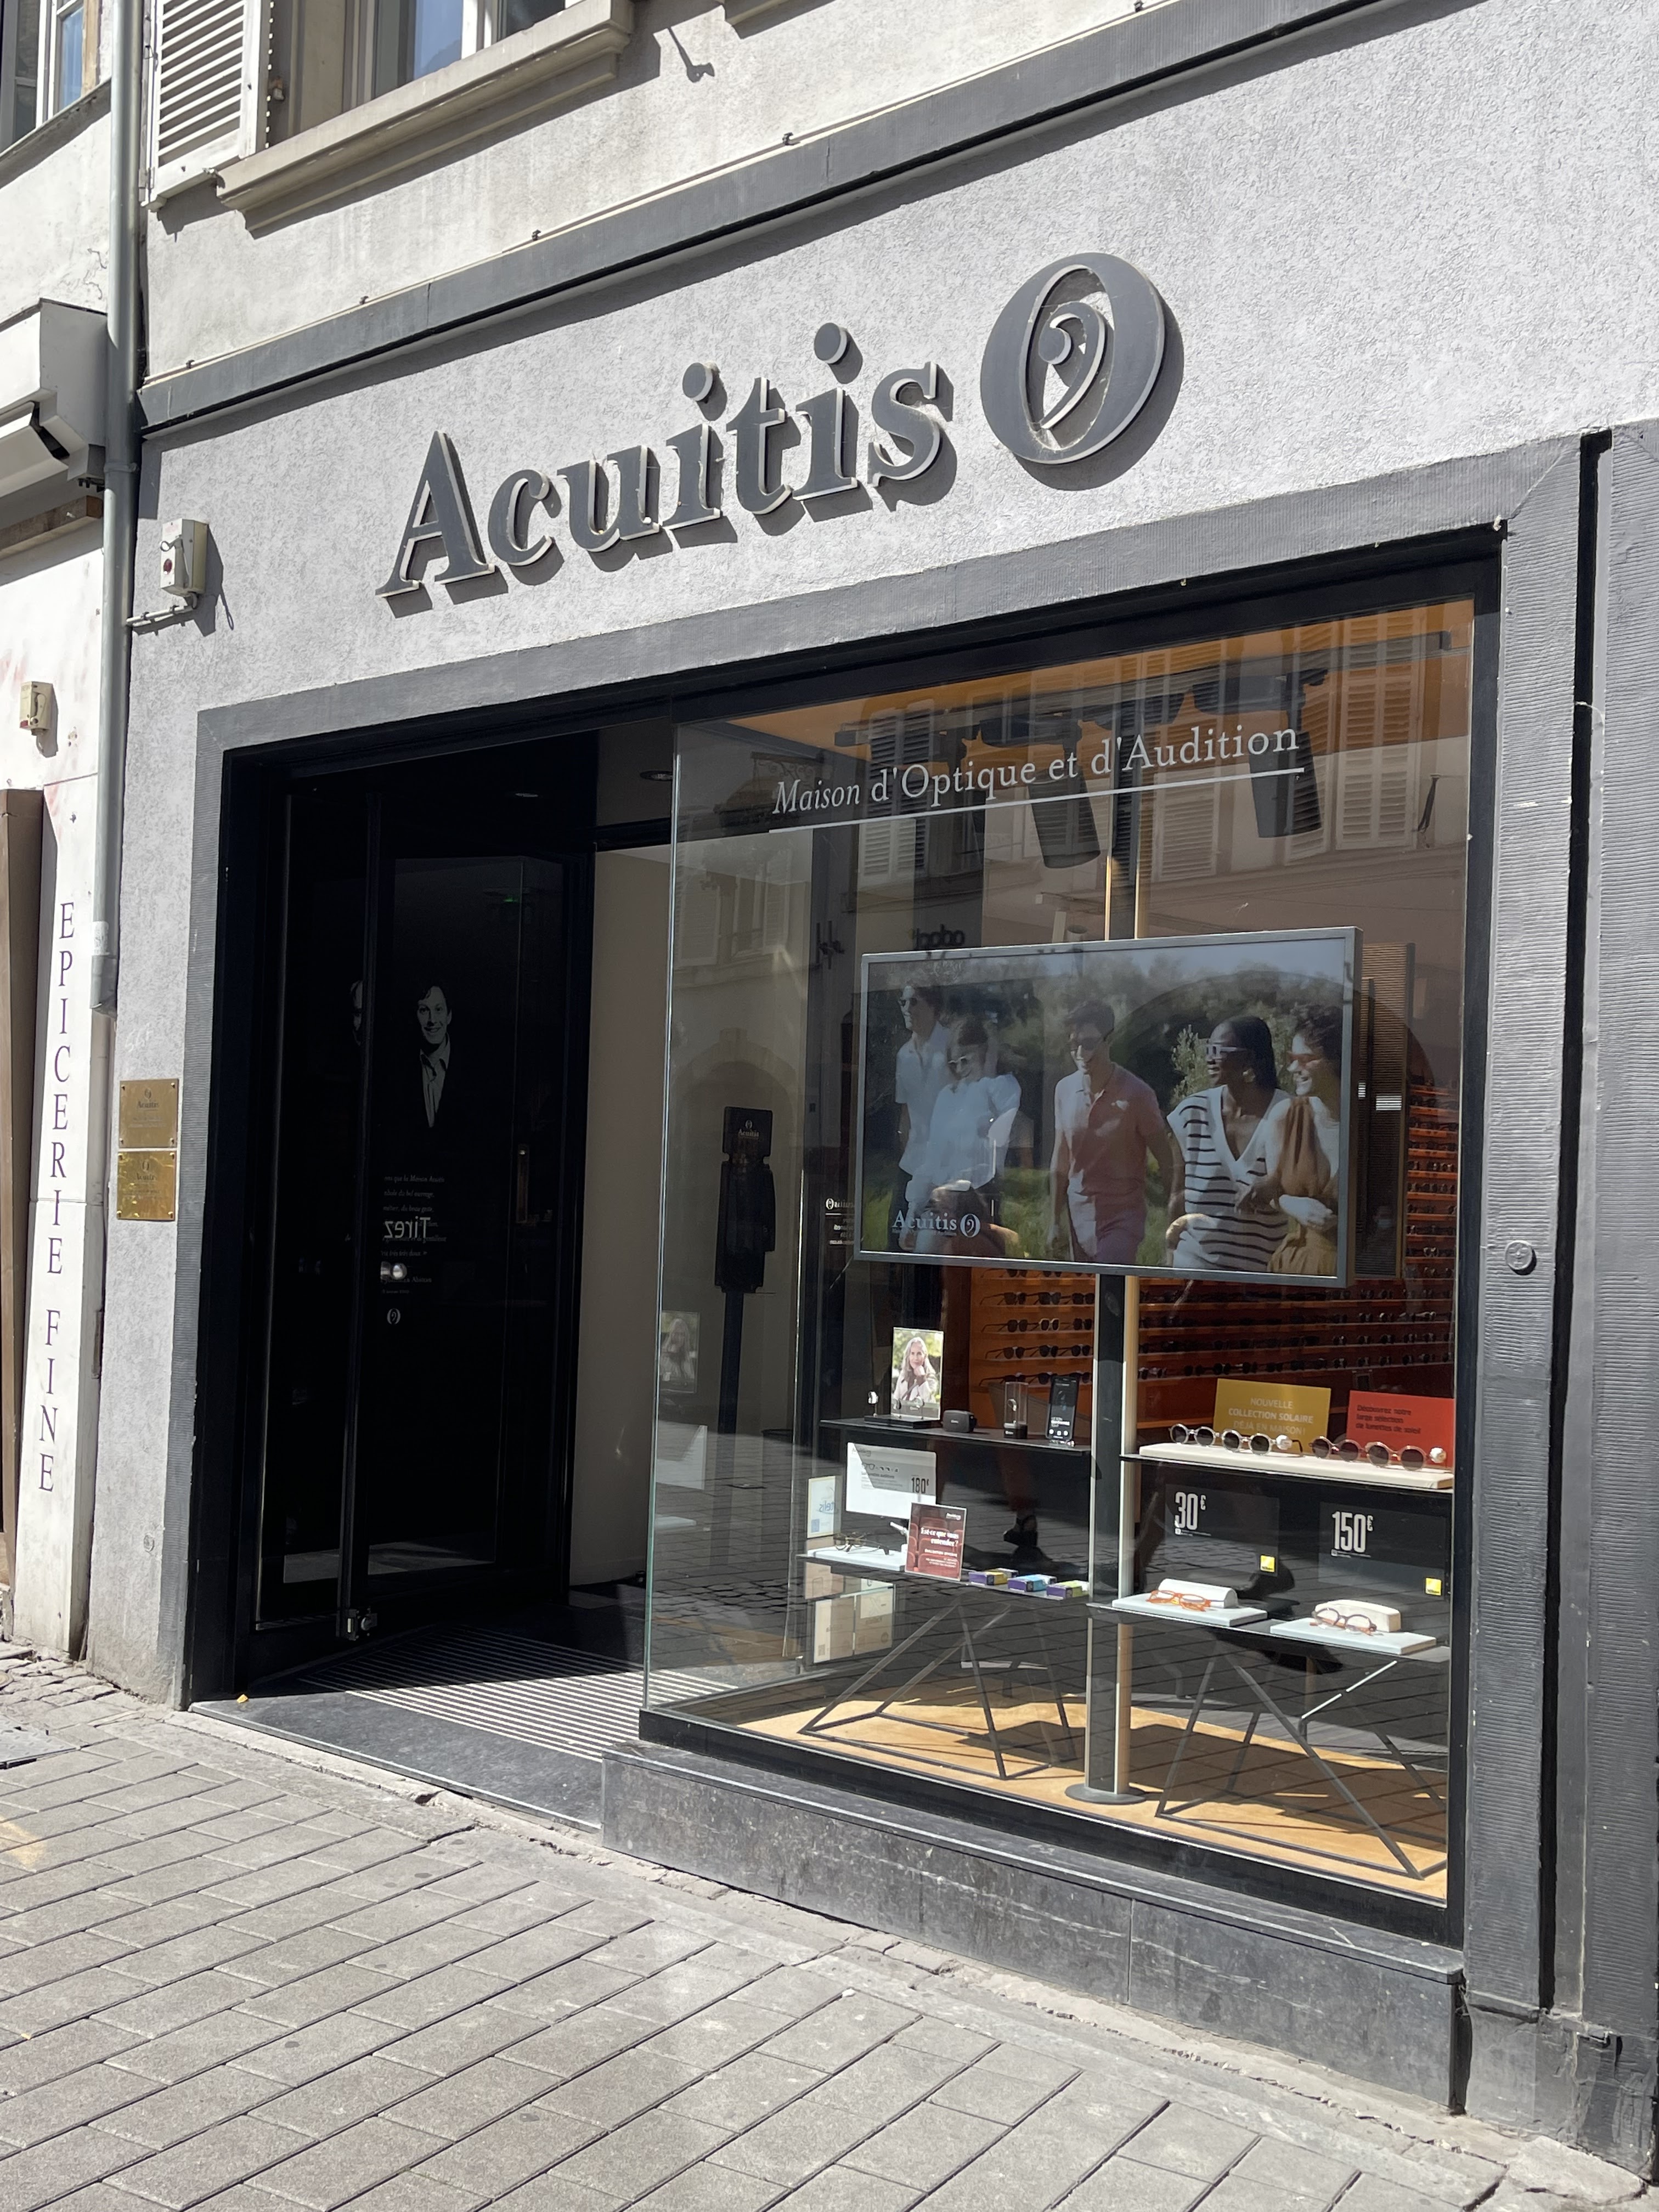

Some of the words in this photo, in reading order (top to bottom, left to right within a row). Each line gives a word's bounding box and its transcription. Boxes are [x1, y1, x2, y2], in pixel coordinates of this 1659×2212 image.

[375, 322, 945, 596] Acuitis
[772, 778, 860, 815] Maison
[871, 760, 1036, 806] d'Optique
[1049, 750, 1077, 781] et
[1091, 724, 1300, 775] d'Audition
[47, 901, 75, 1274] EPICERIE
[891, 1209, 957, 1231] Acuitis
[38, 1309, 61, 1492] FINE
[1228, 1408, 1277, 1420] COLLECTION
[1278, 1413, 1314, 1424] SOLAIRE
[1250, 1397, 1294, 1409] NOUVELLE
[1175, 1492, 1206, 1530] 30€
[1332, 1511, 1374, 1553] 150€
